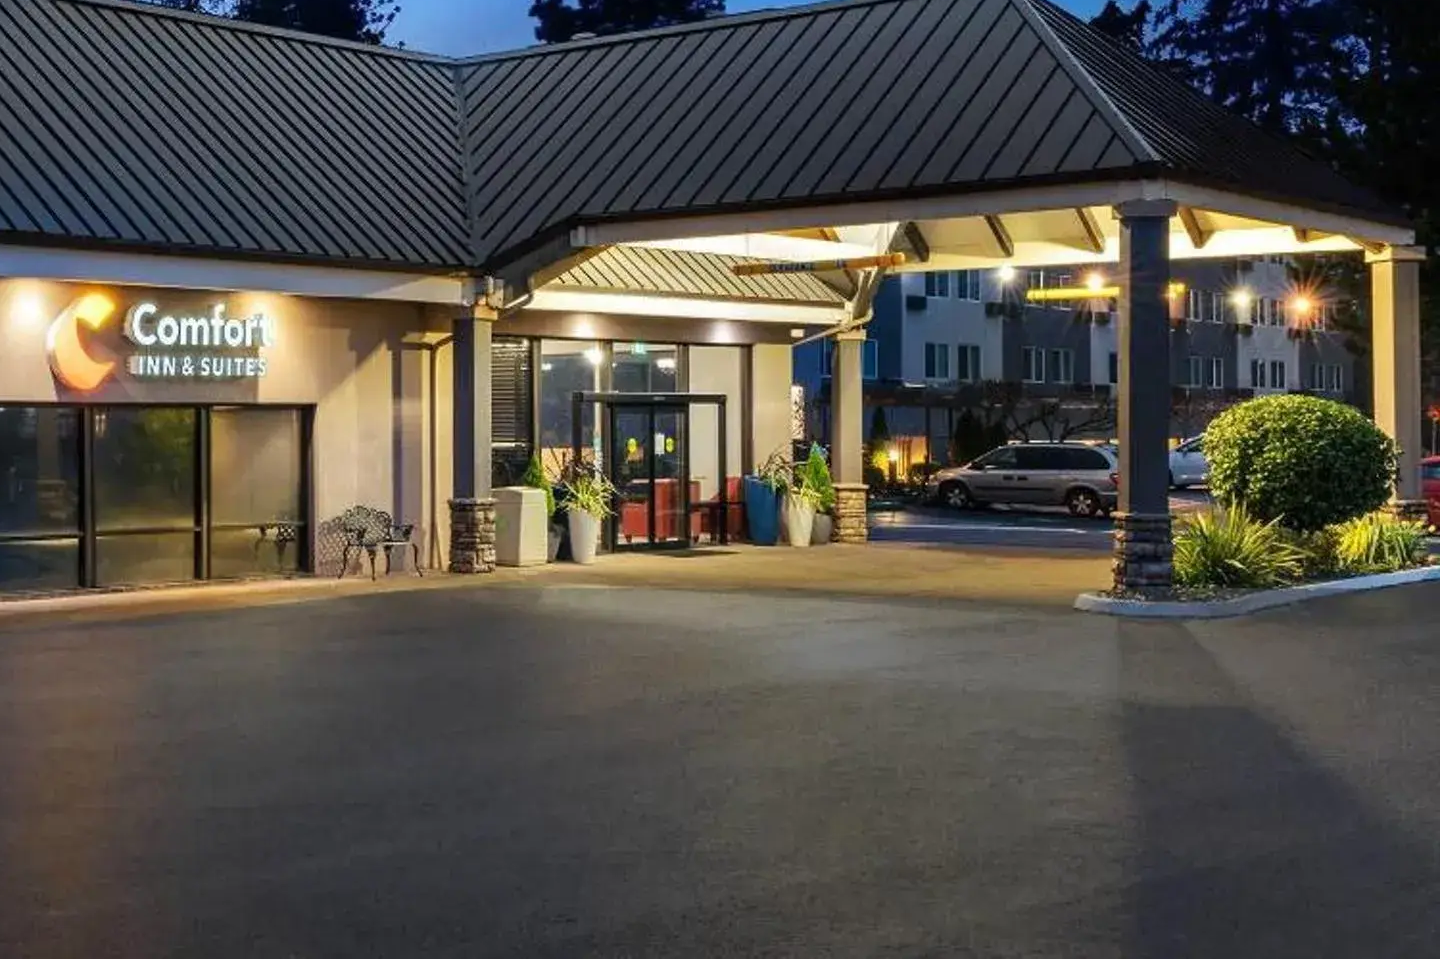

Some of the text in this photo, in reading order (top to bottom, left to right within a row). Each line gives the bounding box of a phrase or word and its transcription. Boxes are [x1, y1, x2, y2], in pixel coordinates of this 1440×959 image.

[131, 303, 273, 347] Comfort
[137, 355, 267, 378] INN & SUITES
